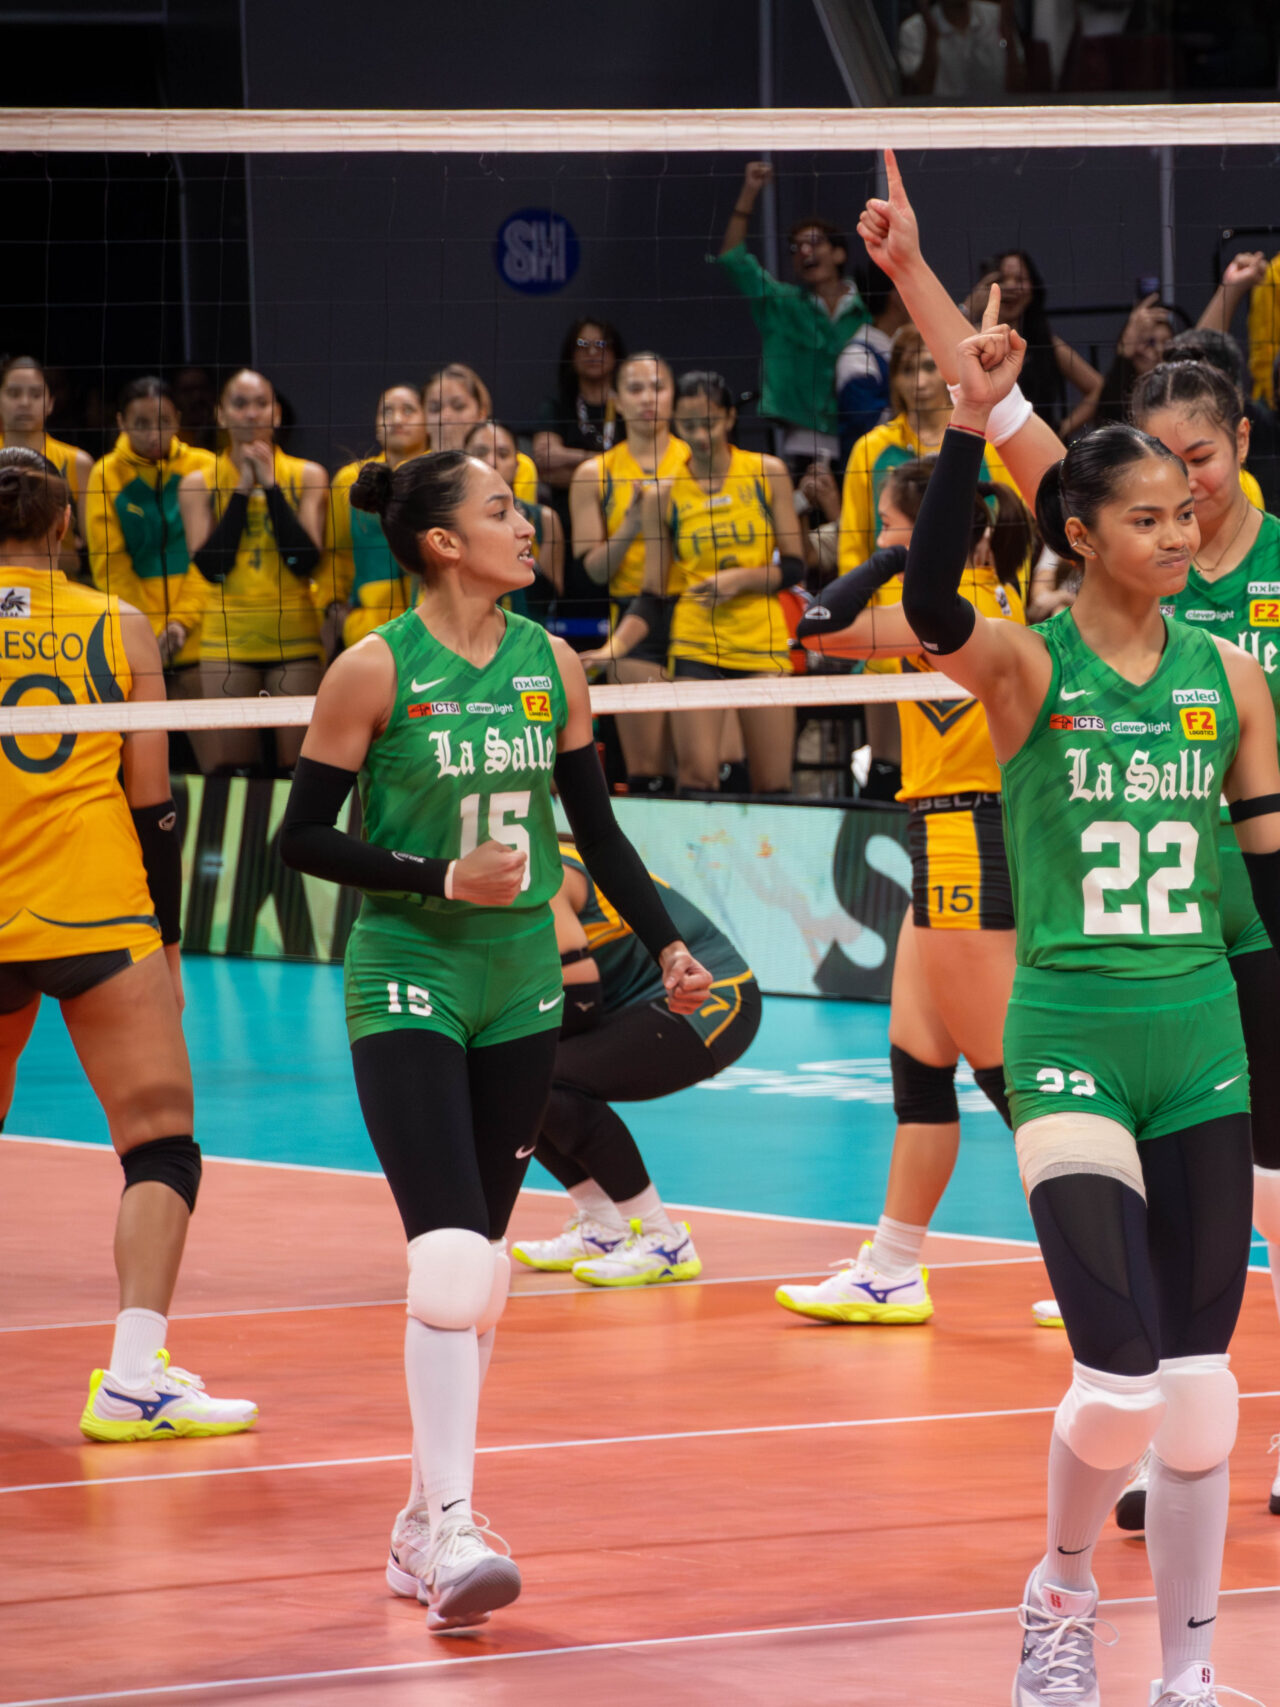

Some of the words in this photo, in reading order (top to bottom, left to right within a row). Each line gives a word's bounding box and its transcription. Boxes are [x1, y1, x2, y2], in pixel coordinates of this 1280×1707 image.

[692, 521, 755, 556] FEU
[1254, 604, 1279, 618] F2
[0, 631, 83, 661] ESCO
[514, 678, 550, 689] nxled
[525, 696, 548, 712] F2
[1175, 691, 1218, 703] nxled
[431, 702, 460, 713] ICTSI
[1074, 717, 1104, 729] ICTS
[1113, 723, 1145, 734] clever
[1148, 722, 1171, 734] light
[1185, 711, 1213, 730] F2
[428, 730, 475, 778] La
[484, 725, 553, 774] Salle
[1065, 748, 1114, 802] La
[1124, 748, 1215, 803] Salle
[1081, 821, 1202, 935] 22
[932, 885, 974, 913] 15
[387, 982, 432, 1016] 15
